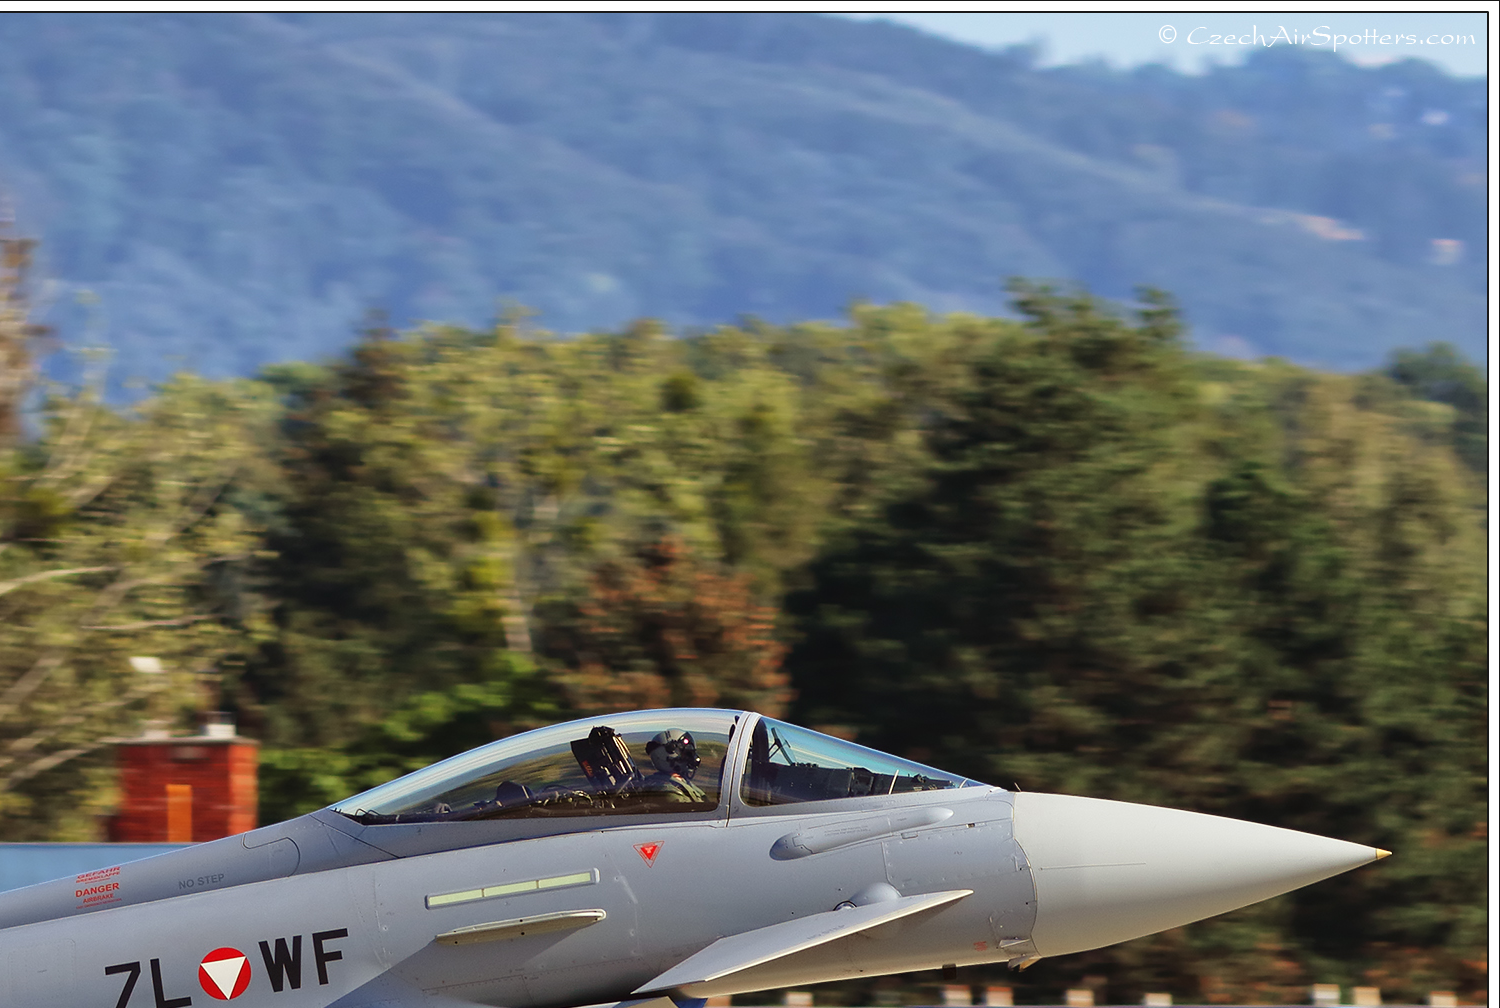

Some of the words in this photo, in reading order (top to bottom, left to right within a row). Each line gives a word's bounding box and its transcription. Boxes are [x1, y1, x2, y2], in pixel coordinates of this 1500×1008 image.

[75, 882, 120, 898] DANGER
[178, 878, 194, 890] NO
[197, 873, 225, 886] STEP
[258, 927, 349, 993] WF
